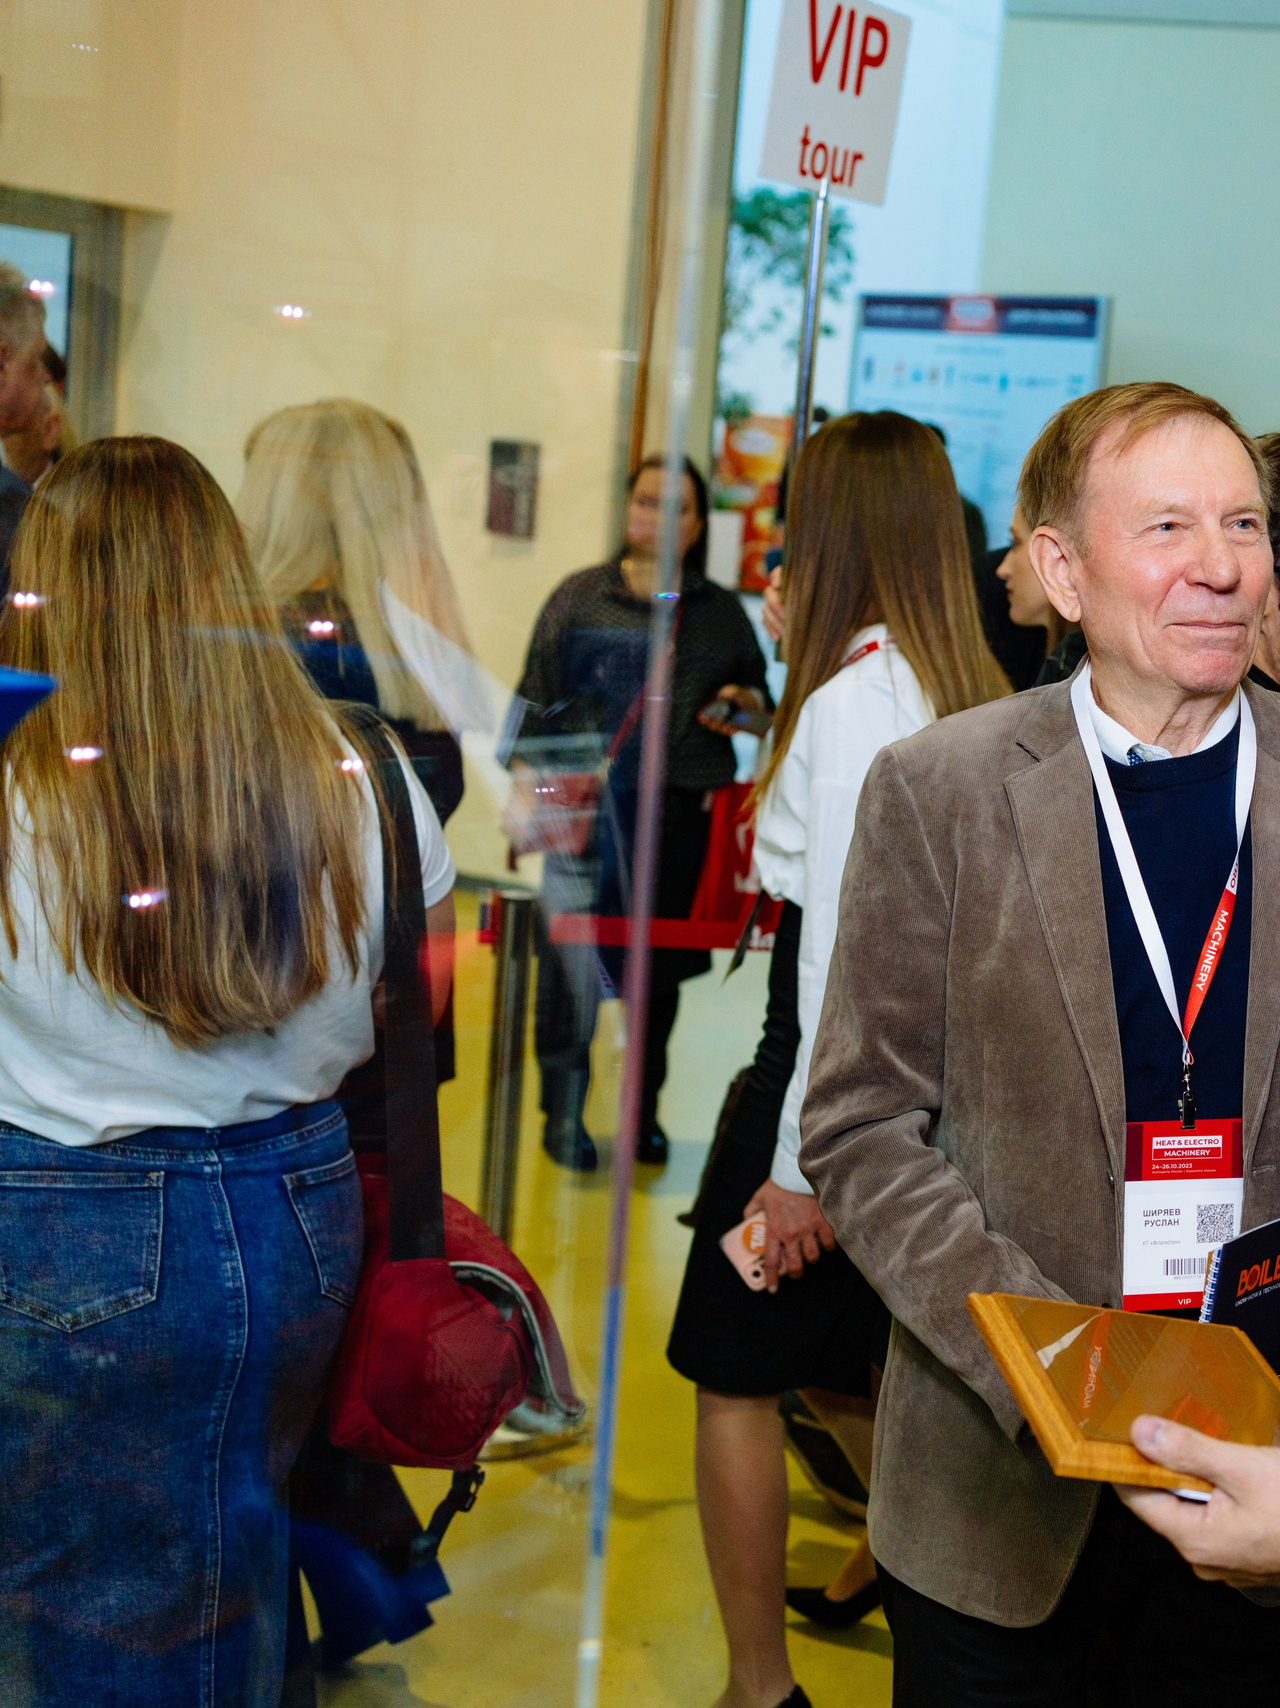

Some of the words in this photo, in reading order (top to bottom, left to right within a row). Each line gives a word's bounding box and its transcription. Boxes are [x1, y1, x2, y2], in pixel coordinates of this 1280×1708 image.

[808, 0, 889, 97] VIP
[799, 124, 864, 187] tour
[1195, 909, 1229, 991] MACHINERY
[1155, 1139, 1176, 1147] HEAT
[1184, 1138, 1220, 1146] ELECTRO
[1163, 1149, 1211, 1157] MACHINERY
[1142, 1208, 1181, 1217] ШИРЯЕВ
[1144, 1218, 1180, 1227] РУСЛАН
[1177, 1298, 1192, 1306] VIP
